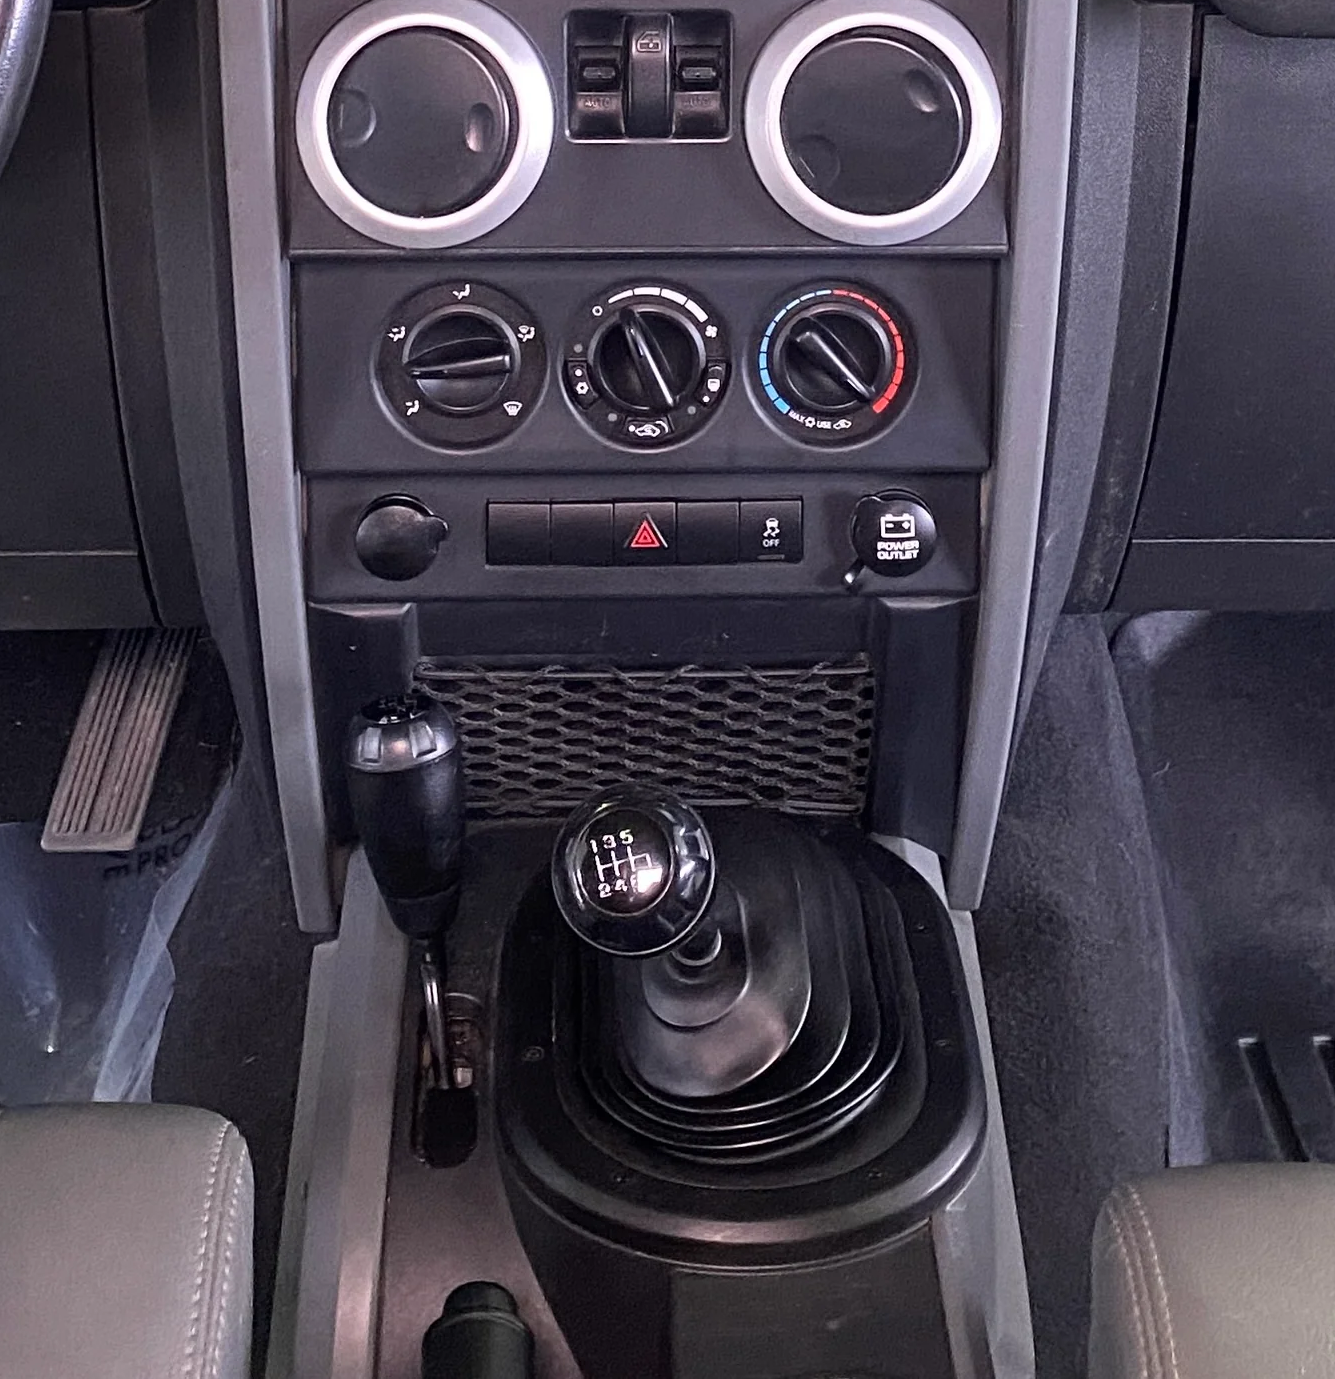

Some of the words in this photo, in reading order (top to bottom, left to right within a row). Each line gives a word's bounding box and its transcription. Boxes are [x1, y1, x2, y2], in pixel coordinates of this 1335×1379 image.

[762, 538, 781, 548] OFF
[876, 540, 920, 552] POWER
[876, 549, 920, 561] OUTLET
[589, 838, 599, 854] 1
[602, 833, 617, 850] 3
[619, 828, 635, 845] 5
[596, 882, 613, 899] 2
[614, 879, 629, 893] 4
